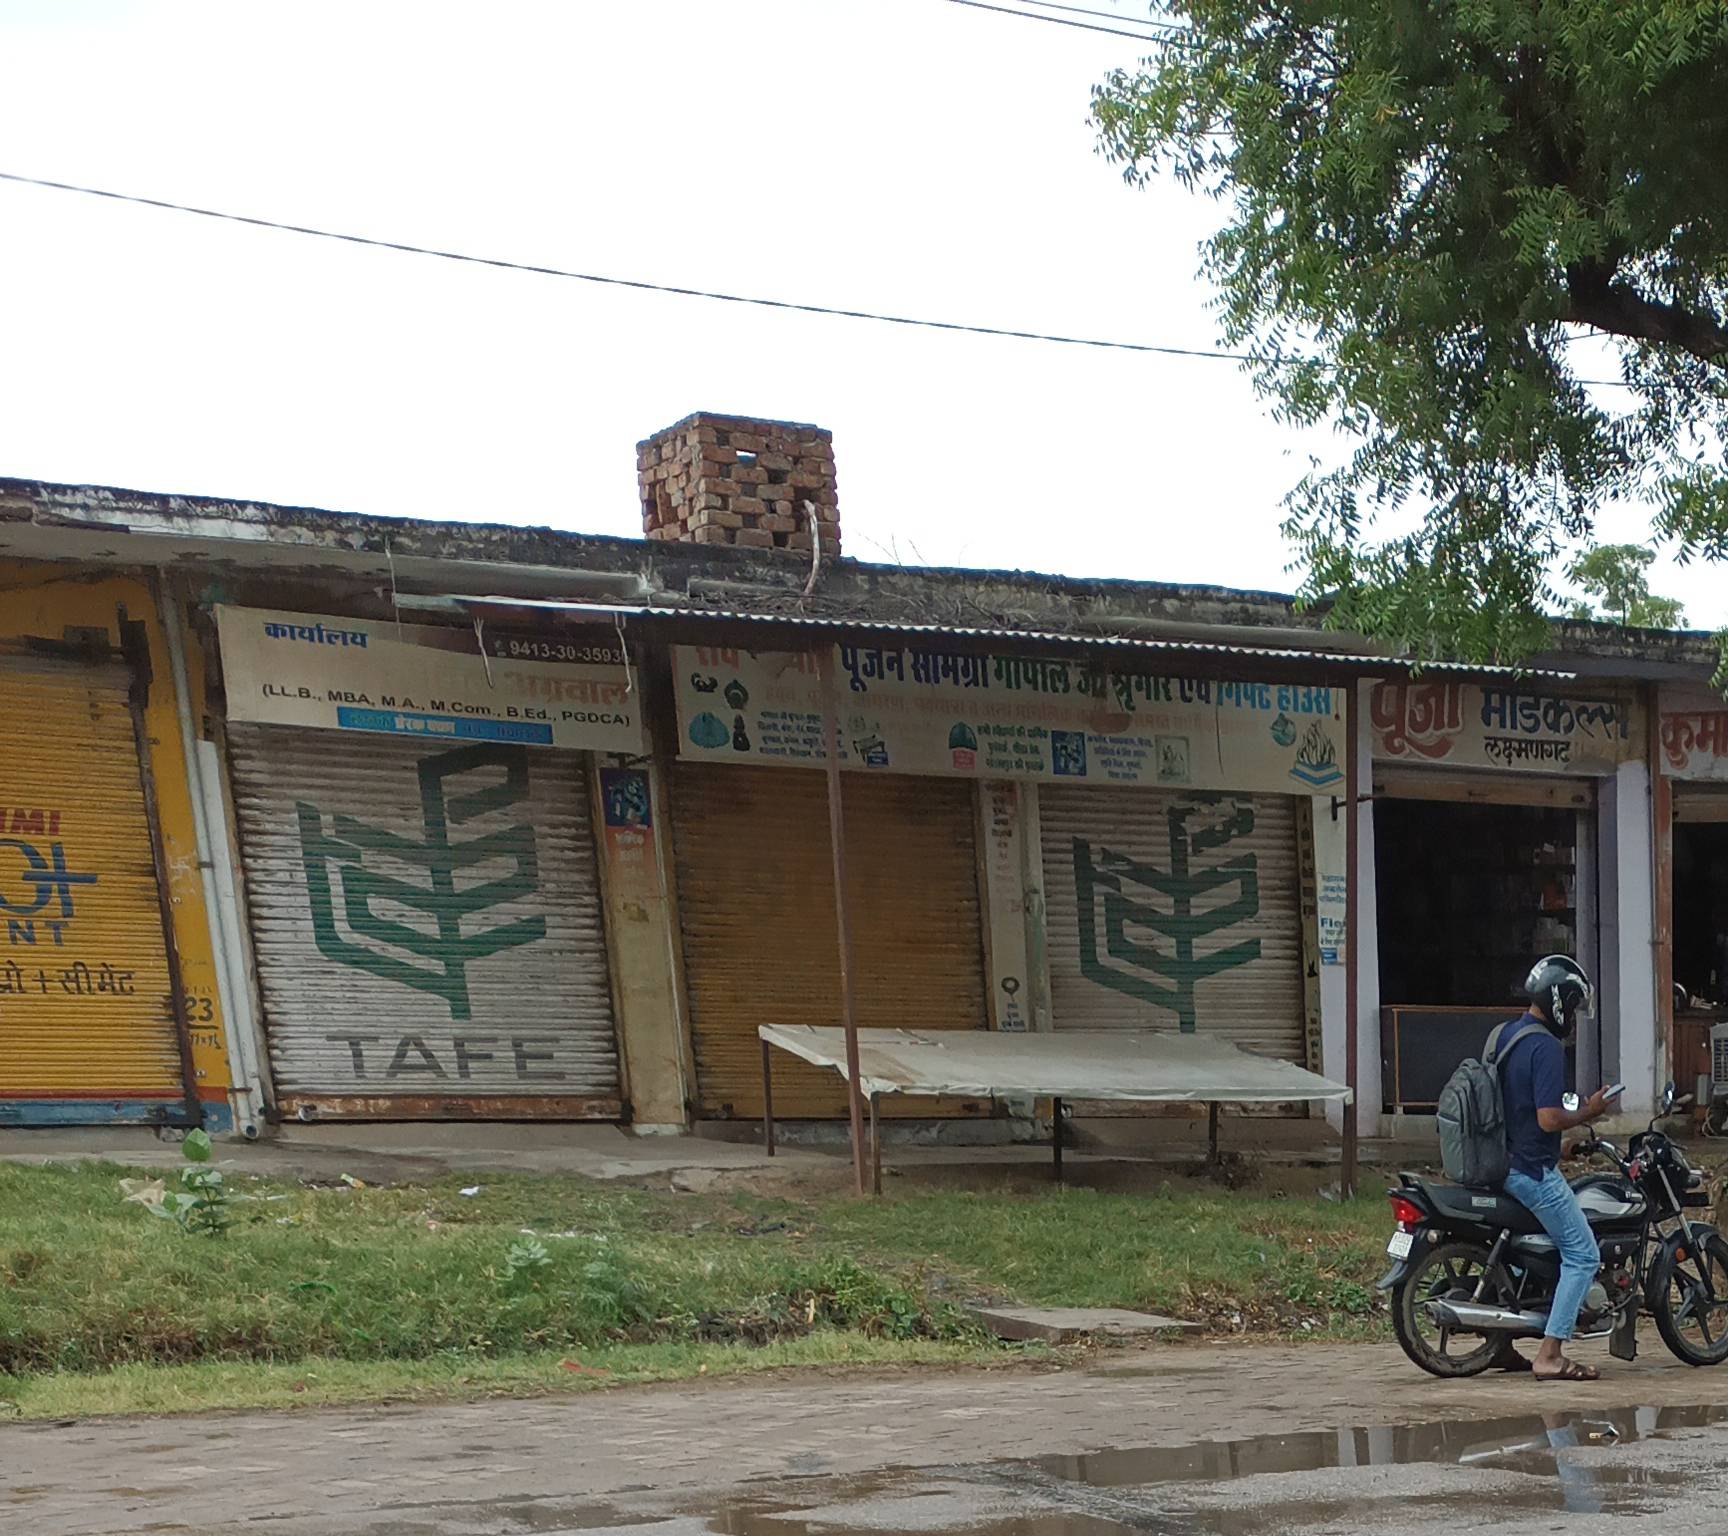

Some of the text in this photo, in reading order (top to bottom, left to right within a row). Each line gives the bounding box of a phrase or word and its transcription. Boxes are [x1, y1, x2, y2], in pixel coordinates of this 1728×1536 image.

[263, 623, 369, 648] कार्यालय
[841, 647, 904, 692] पूजन
[328, 690, 376, 706] MBA,
[562, 711, 630, 726] PGDCA)
[1370, 680, 1464, 758] पूजा
[0, 807, 61, 836] MI
[325, 1033, 567, 1081] TAFE
